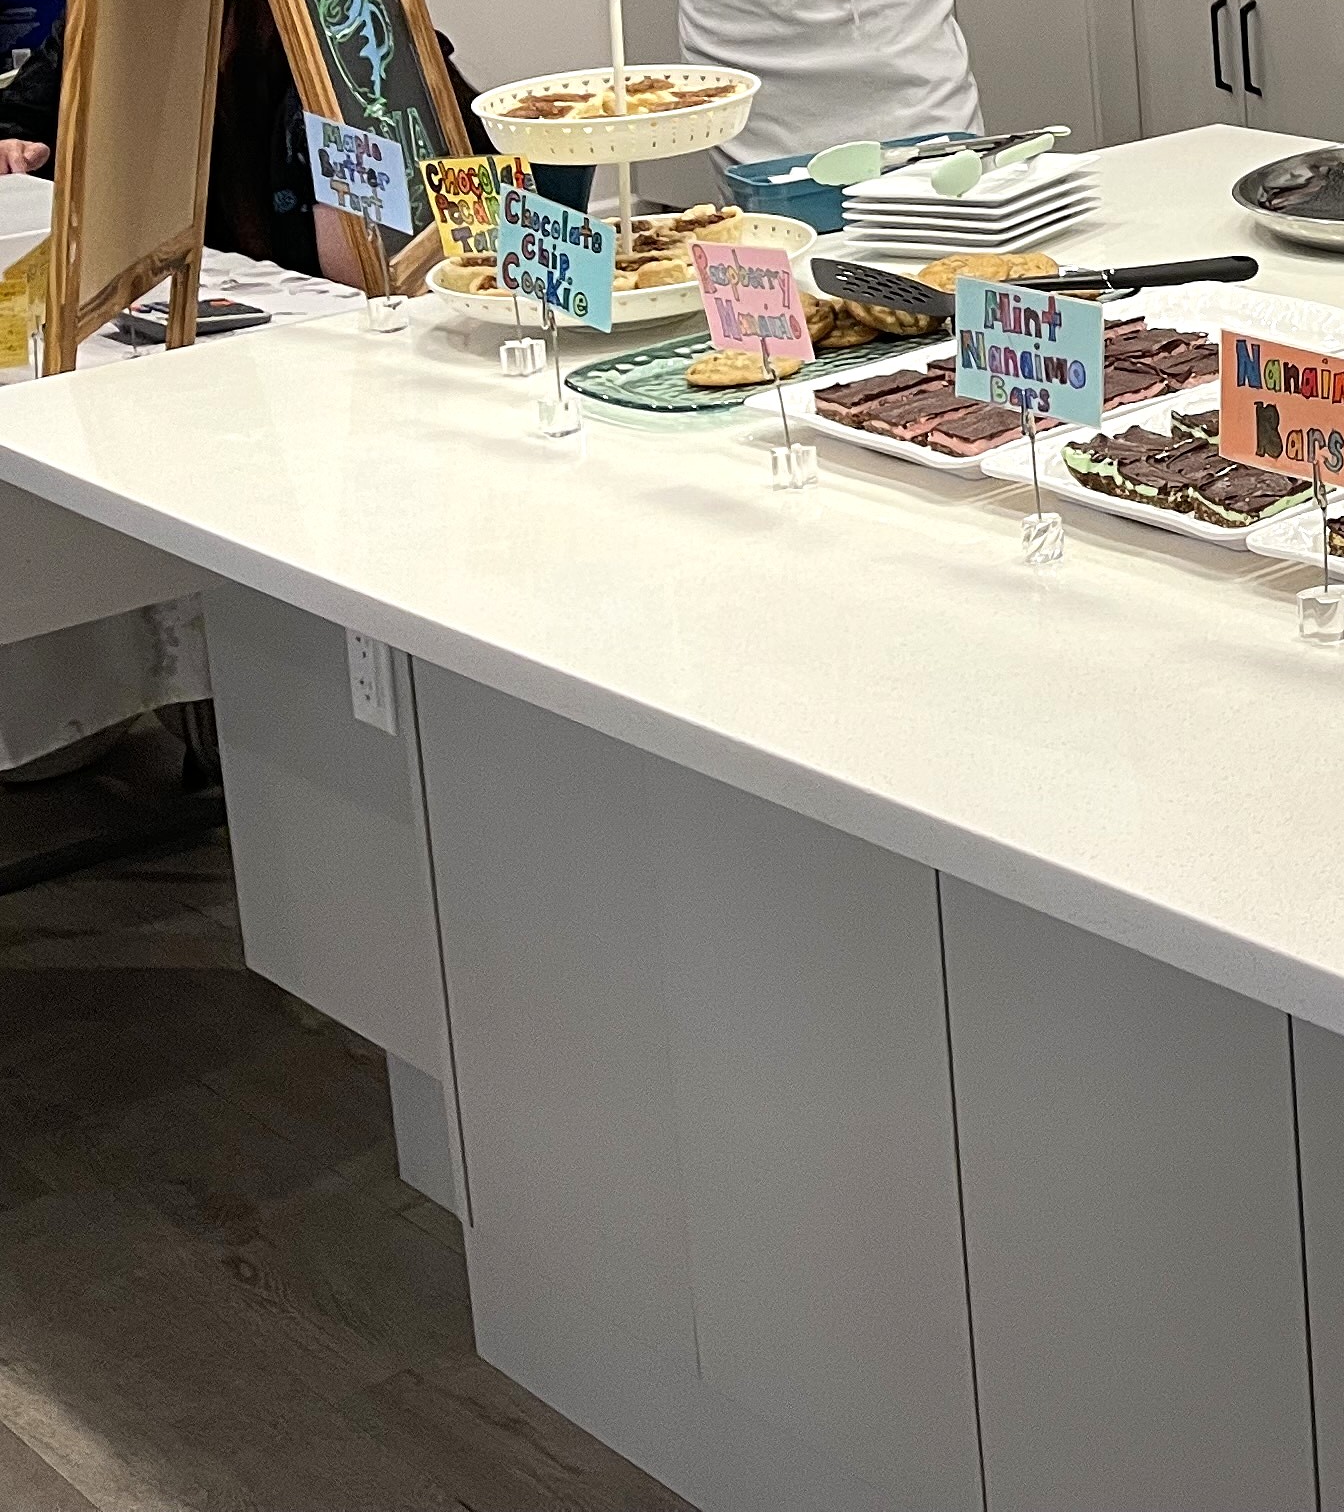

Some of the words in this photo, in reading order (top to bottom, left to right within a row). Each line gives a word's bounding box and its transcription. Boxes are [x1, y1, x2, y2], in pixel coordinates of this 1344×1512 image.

[504, 189, 603, 254] Chocolate
[502, 251, 589, 318] Cookie
[984, 289, 1062, 343] Mint
[960, 329, 1087, 390] Nanaimo
[990, 374, 1051, 413] Bars
